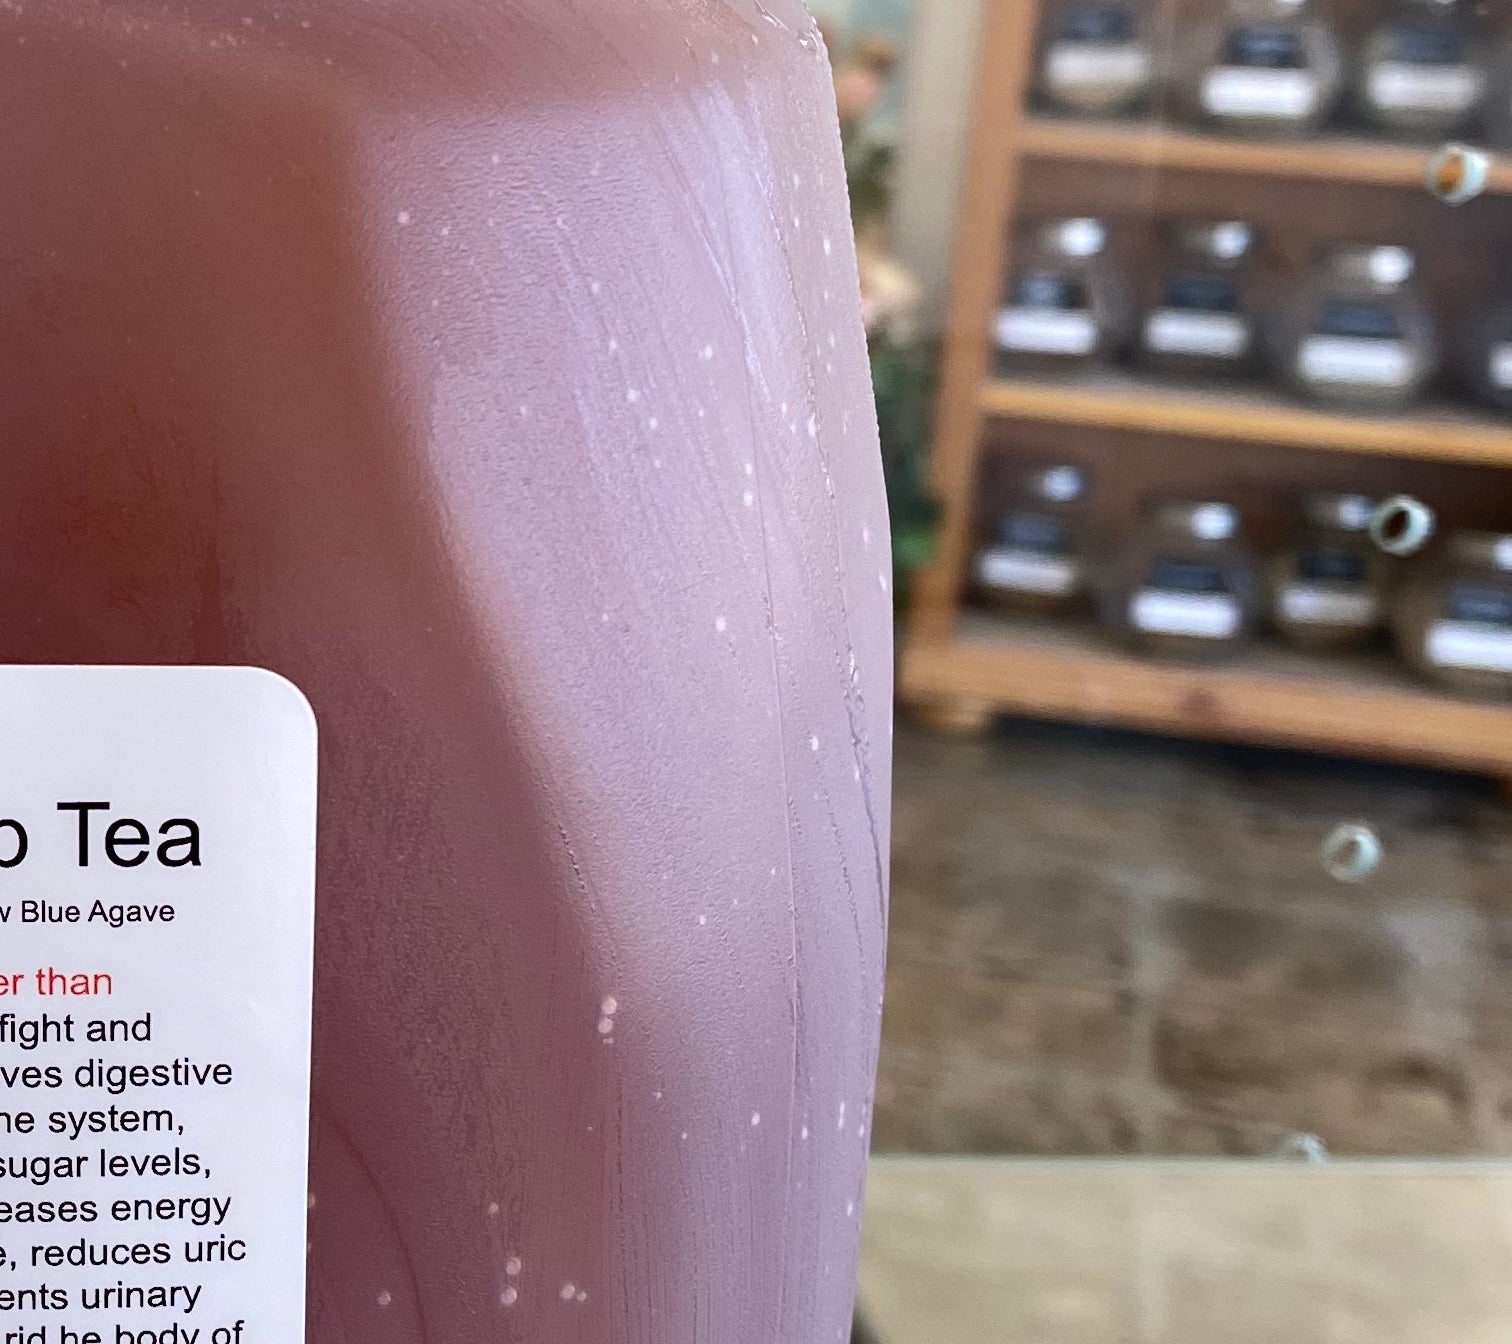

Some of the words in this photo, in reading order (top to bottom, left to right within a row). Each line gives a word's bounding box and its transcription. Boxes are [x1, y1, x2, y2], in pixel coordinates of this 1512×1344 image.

[56, 800, 202, 869] Tea
[20, 899, 81, 924] Blue
[86, 898, 176, 929] Agave
[34, 966, 113, 997] than
[85, 1011, 152, 1043] and
[74, 1056, 233, 1096] digestive
[47, 1103, 185, 1142] system,
[100, 1146, 211, 1180] levels,
[110, 1195, 233, 1227] energy
[31, 1236, 172, 1267] reduces
[184, 1232, 247, 1264] uric
[81, 1279, 203, 1315] urinary
